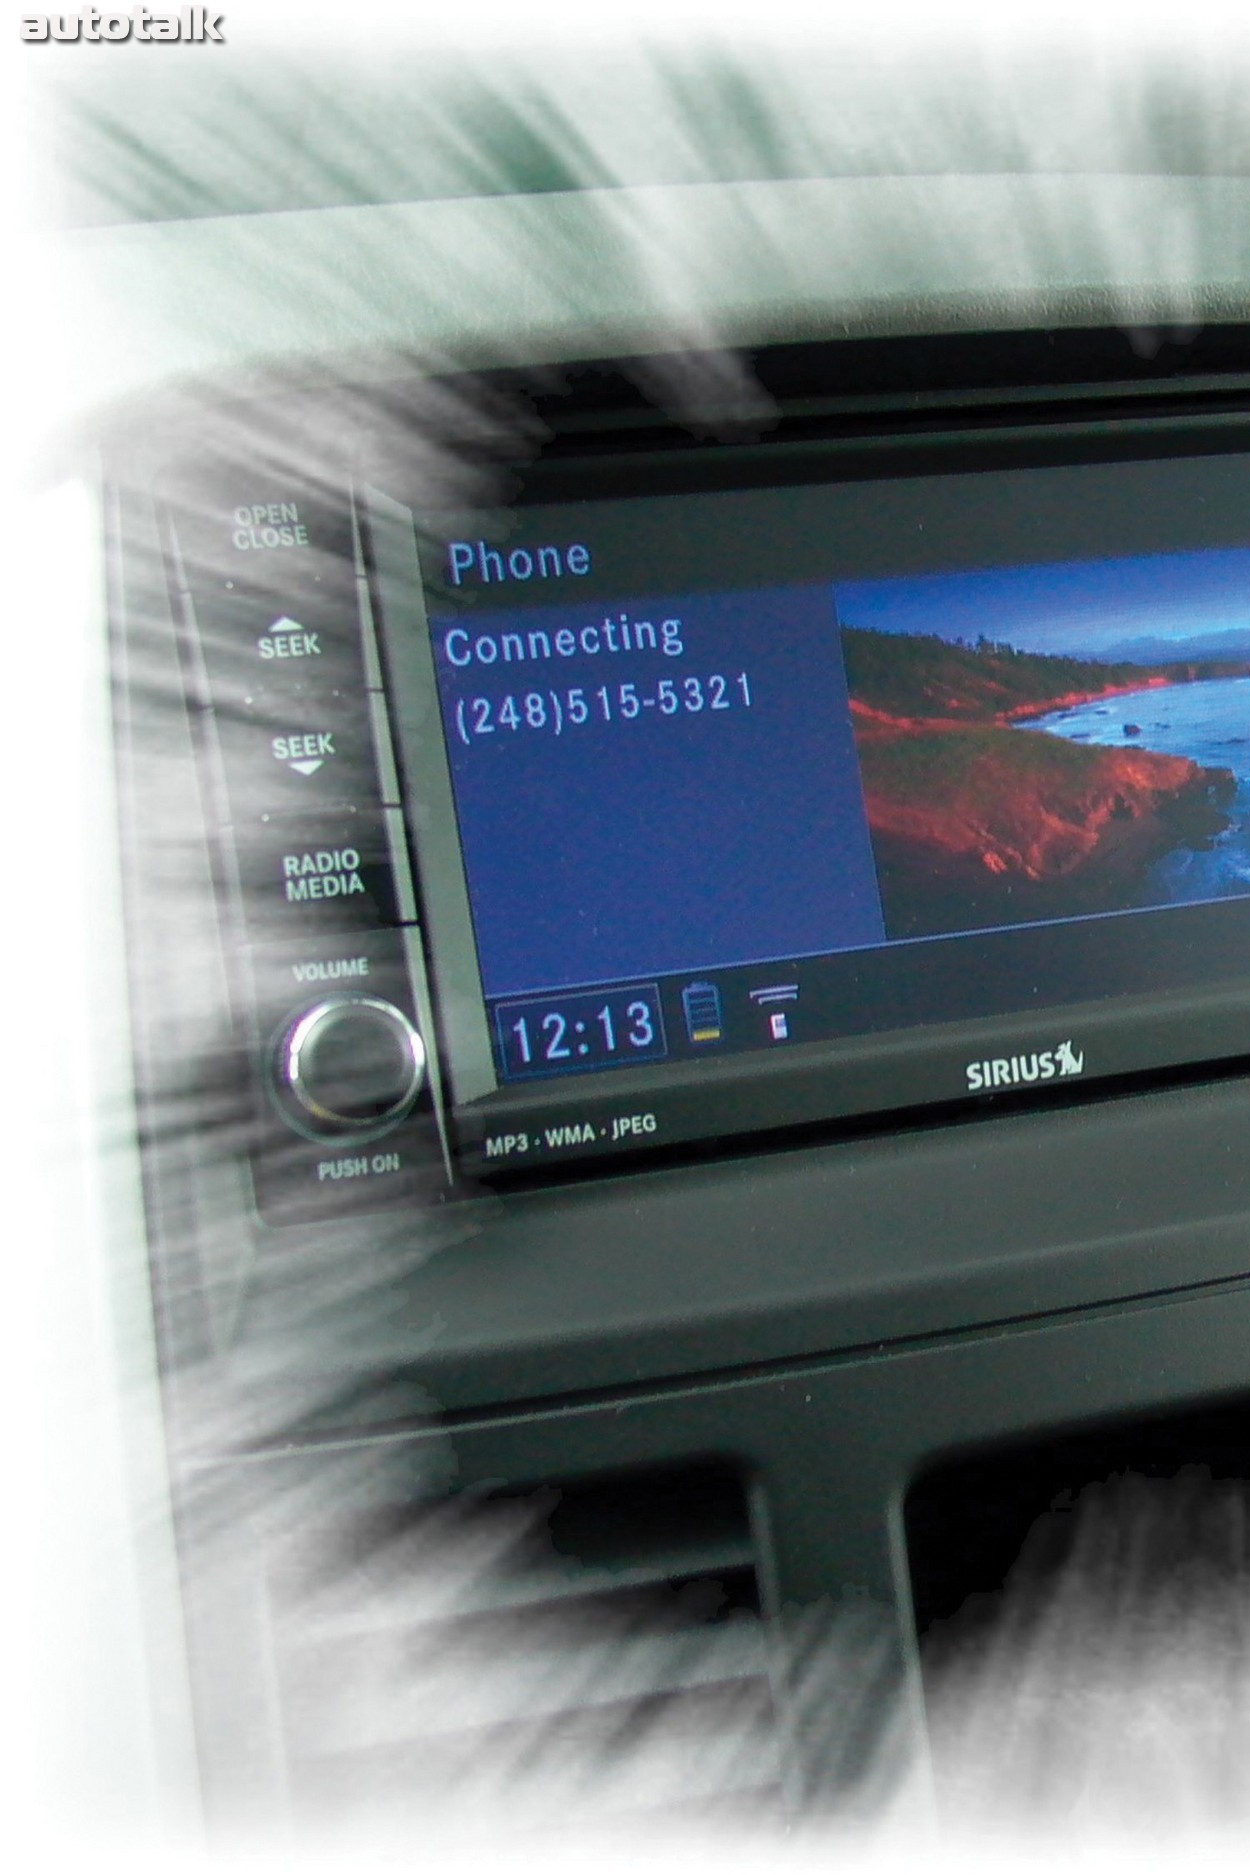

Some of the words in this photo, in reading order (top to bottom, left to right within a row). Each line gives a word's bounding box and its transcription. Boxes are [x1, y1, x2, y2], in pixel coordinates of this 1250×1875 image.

[235, 503, 299, 526] OPEN
[233, 526, 309, 550] CLOSE
[449, 541, 591, 585] Phone
[258, 633, 321, 659] SEEK
[445, 614, 684, 666] Connecting
[456, 672, 752, 745] (248)515-5321
[272, 733, 335, 759] SEEK
[283, 850, 361, 876] RADIO
[286, 873, 365, 901] MEDIA
[292, 957, 369, 982] VOLUME
[512, 1001, 655, 1063] 12:13
[966, 1050, 1055, 1090] SIRIUS
[486, 1134, 529, 1158] MP3
[545, 1124, 595, 1147] WMA
[611, 1114, 657, 1140] JPEG
[318, 1157, 368, 1181] PUSH
[371, 1153, 400, 1174] ON
